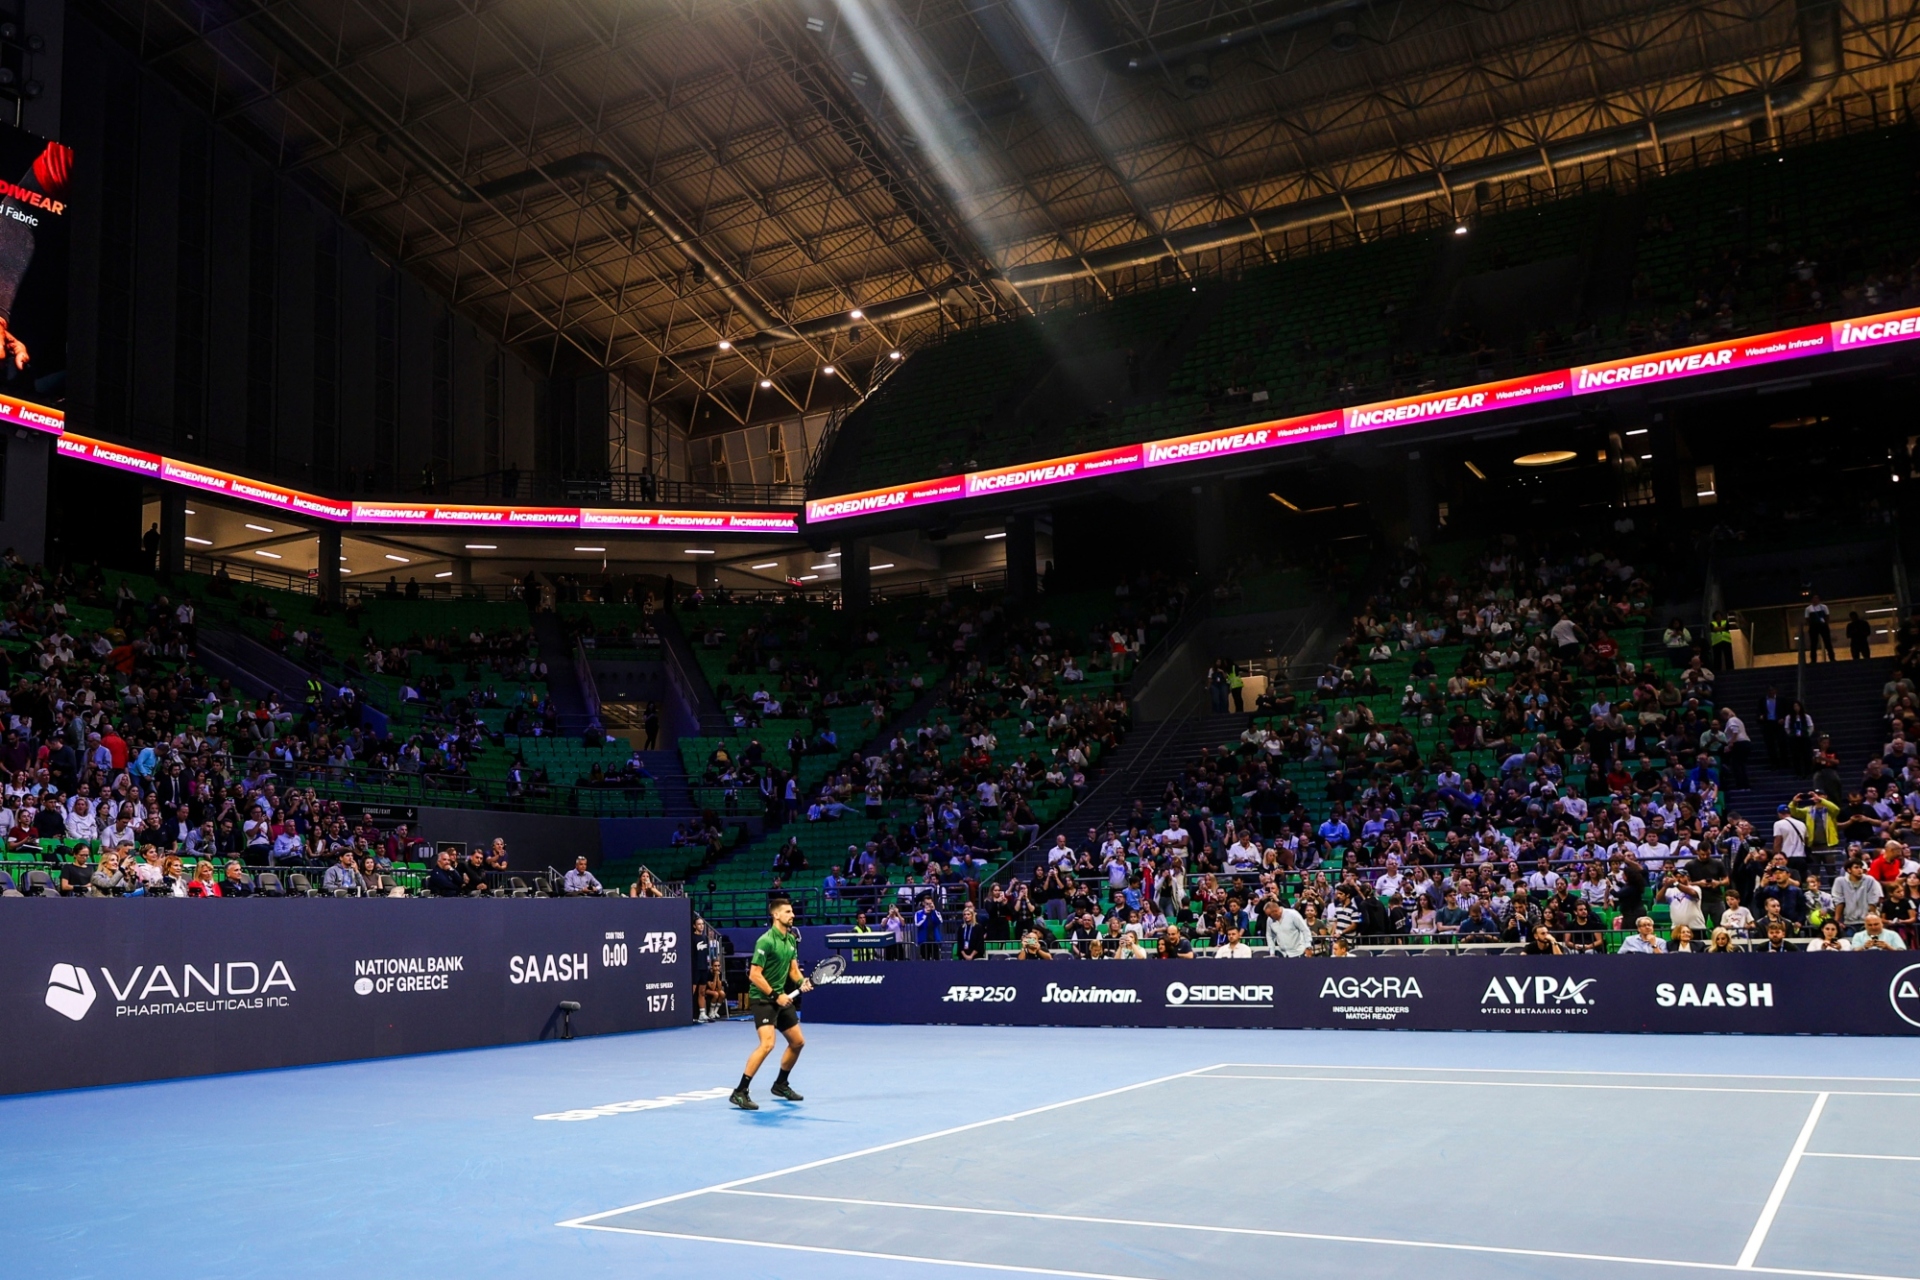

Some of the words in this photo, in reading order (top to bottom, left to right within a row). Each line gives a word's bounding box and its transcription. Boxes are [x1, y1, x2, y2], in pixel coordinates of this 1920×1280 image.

[5, 206, 39, 227] Fabric
[1745, 343, 1787, 357] Wearable
[1788, 336, 1824, 349] Infrared
[1495, 388, 1532, 400] Wearable
[1533, 381, 1565, 394] Infrared
[1277, 426, 1310, 437] Wearable
[1310, 421, 1338, 432] Infrared
[1084, 459, 1113, 470] Wearable
[1113, 455, 1139, 465] Infrared
[638, 931, 677, 954] ATP
[602, 943, 628, 968] 0:00
[661, 952, 677, 965] 250
[355, 957, 426, 976] NATIONAL
[427, 956, 464, 973] BANK
[509, 952, 589, 985] SAASH
[100, 960, 297, 1002] VANDA
[375, 976, 395, 993] OF
[396, 974, 449, 992] GREECE
[1041, 982, 1137, 1003] Stoiximan
[1189, 985, 1274, 1001] SIDENOR
[1656, 982, 1774, 1007] SAASH
[116, 998, 264, 1017] PHARMACEUTICALS
[646, 993, 668, 1013] 157
[1374, 1006, 1410, 1014] BROKERS
